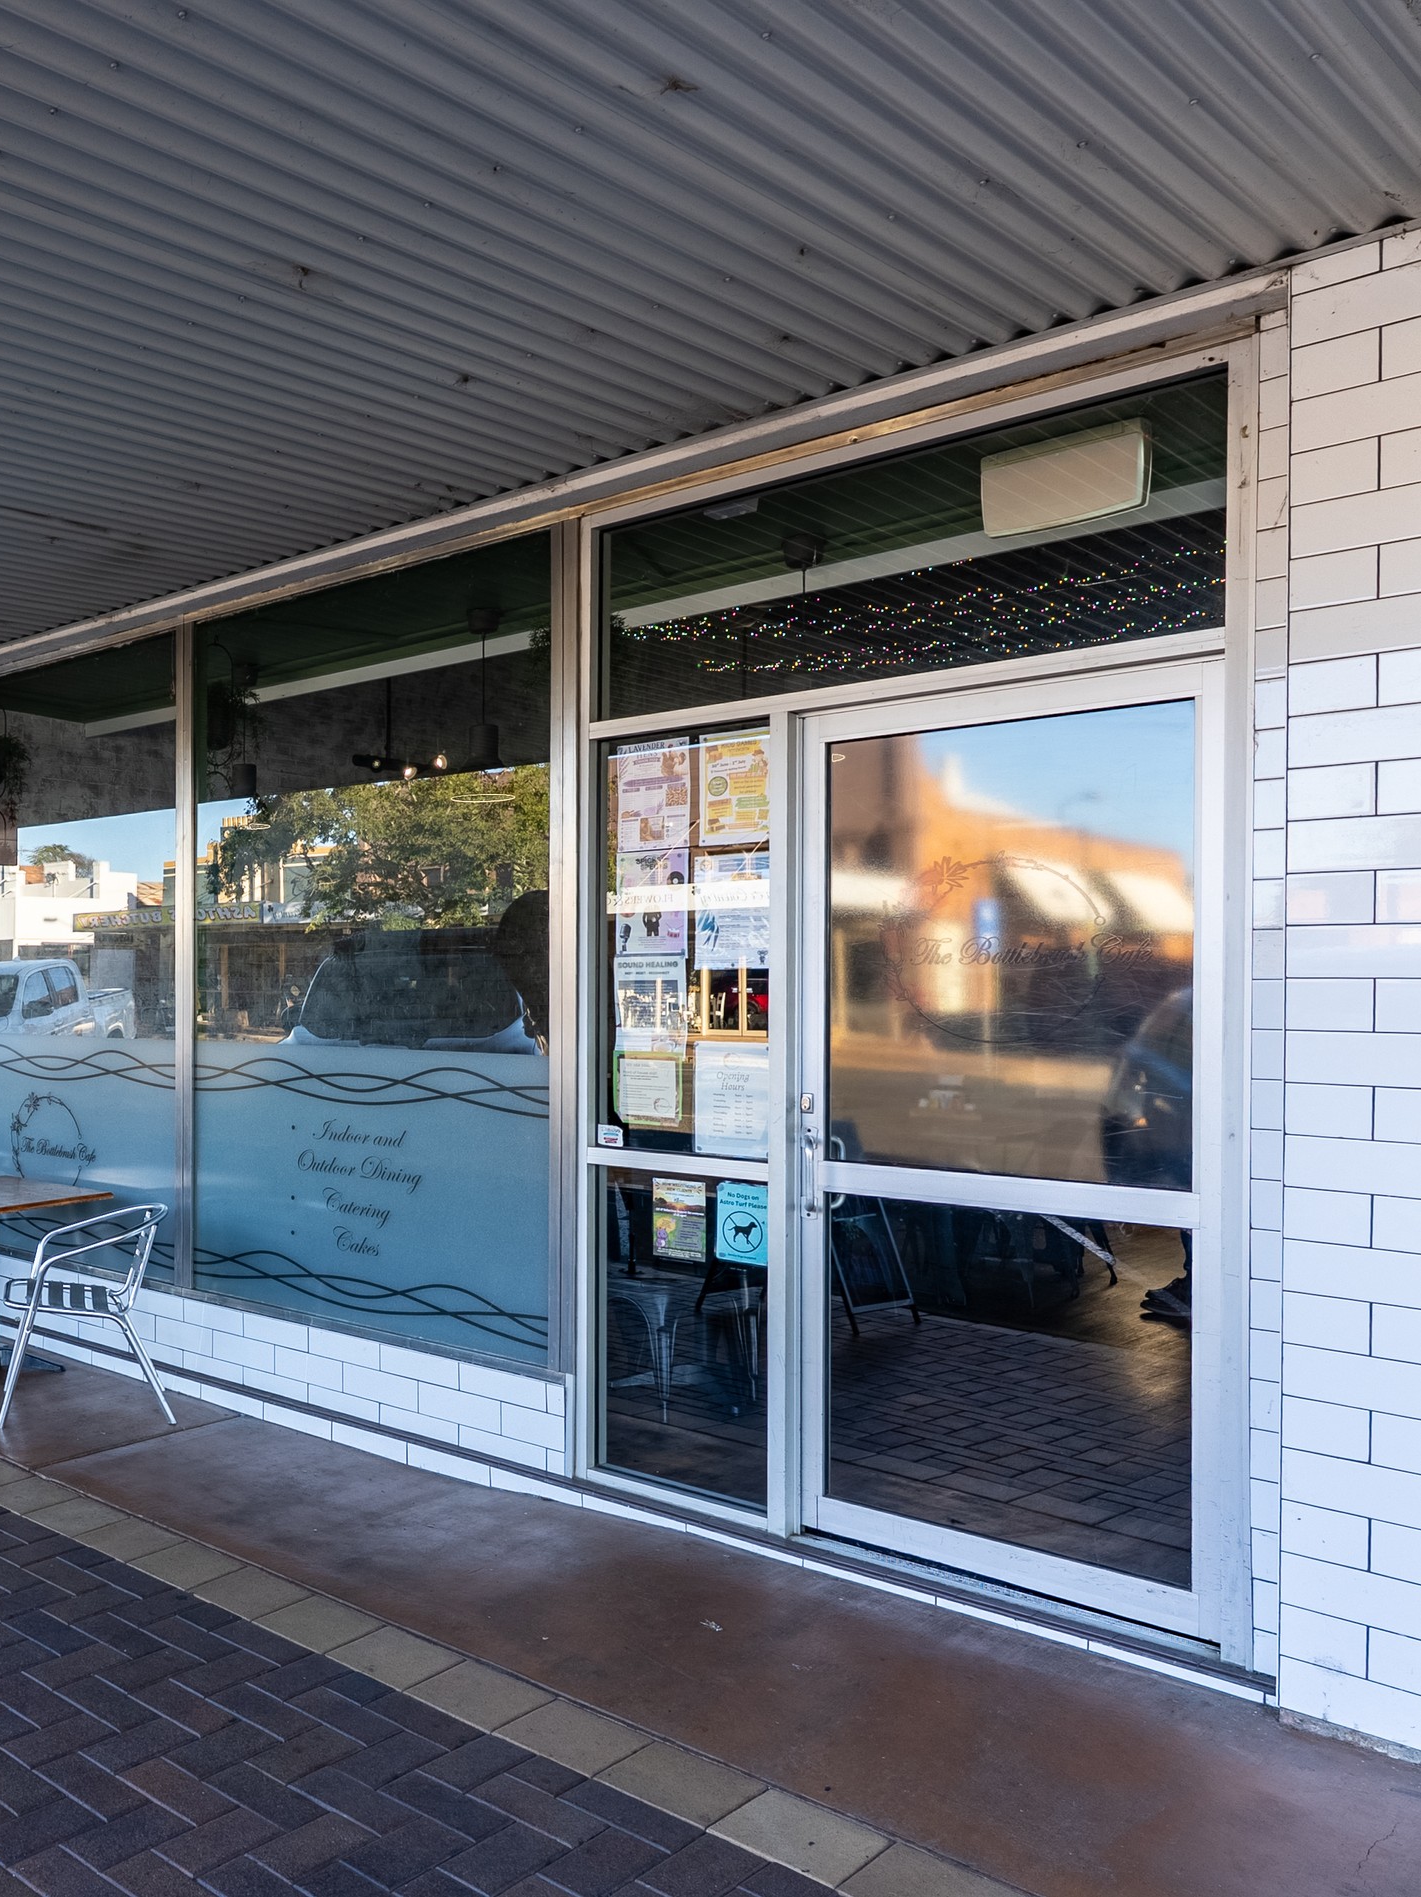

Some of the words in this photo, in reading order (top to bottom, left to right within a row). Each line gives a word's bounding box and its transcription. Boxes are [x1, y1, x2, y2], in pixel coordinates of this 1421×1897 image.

[628, 742, 665, 754] LAVENDER
[909, 937, 952, 966] The
[618, 961, 644, 969] SOUND
[716, 1071, 750, 1083] Opening
[721, 1082, 745, 1091] Hours
[312, 1118, 371, 1144] Indoor
[372, 1130, 407, 1148] and
[20, 1136, 35, 1153] The
[36, 1138, 77, 1160] Bottlebrush
[297, 1148, 356, 1176] Outdoor
[360, 1155, 423, 1195] Dining
[322, 1186, 391, 1230] Catering
[748, 1202, 767, 1210] Please
[332, 1225, 381, 1257] Cakes
